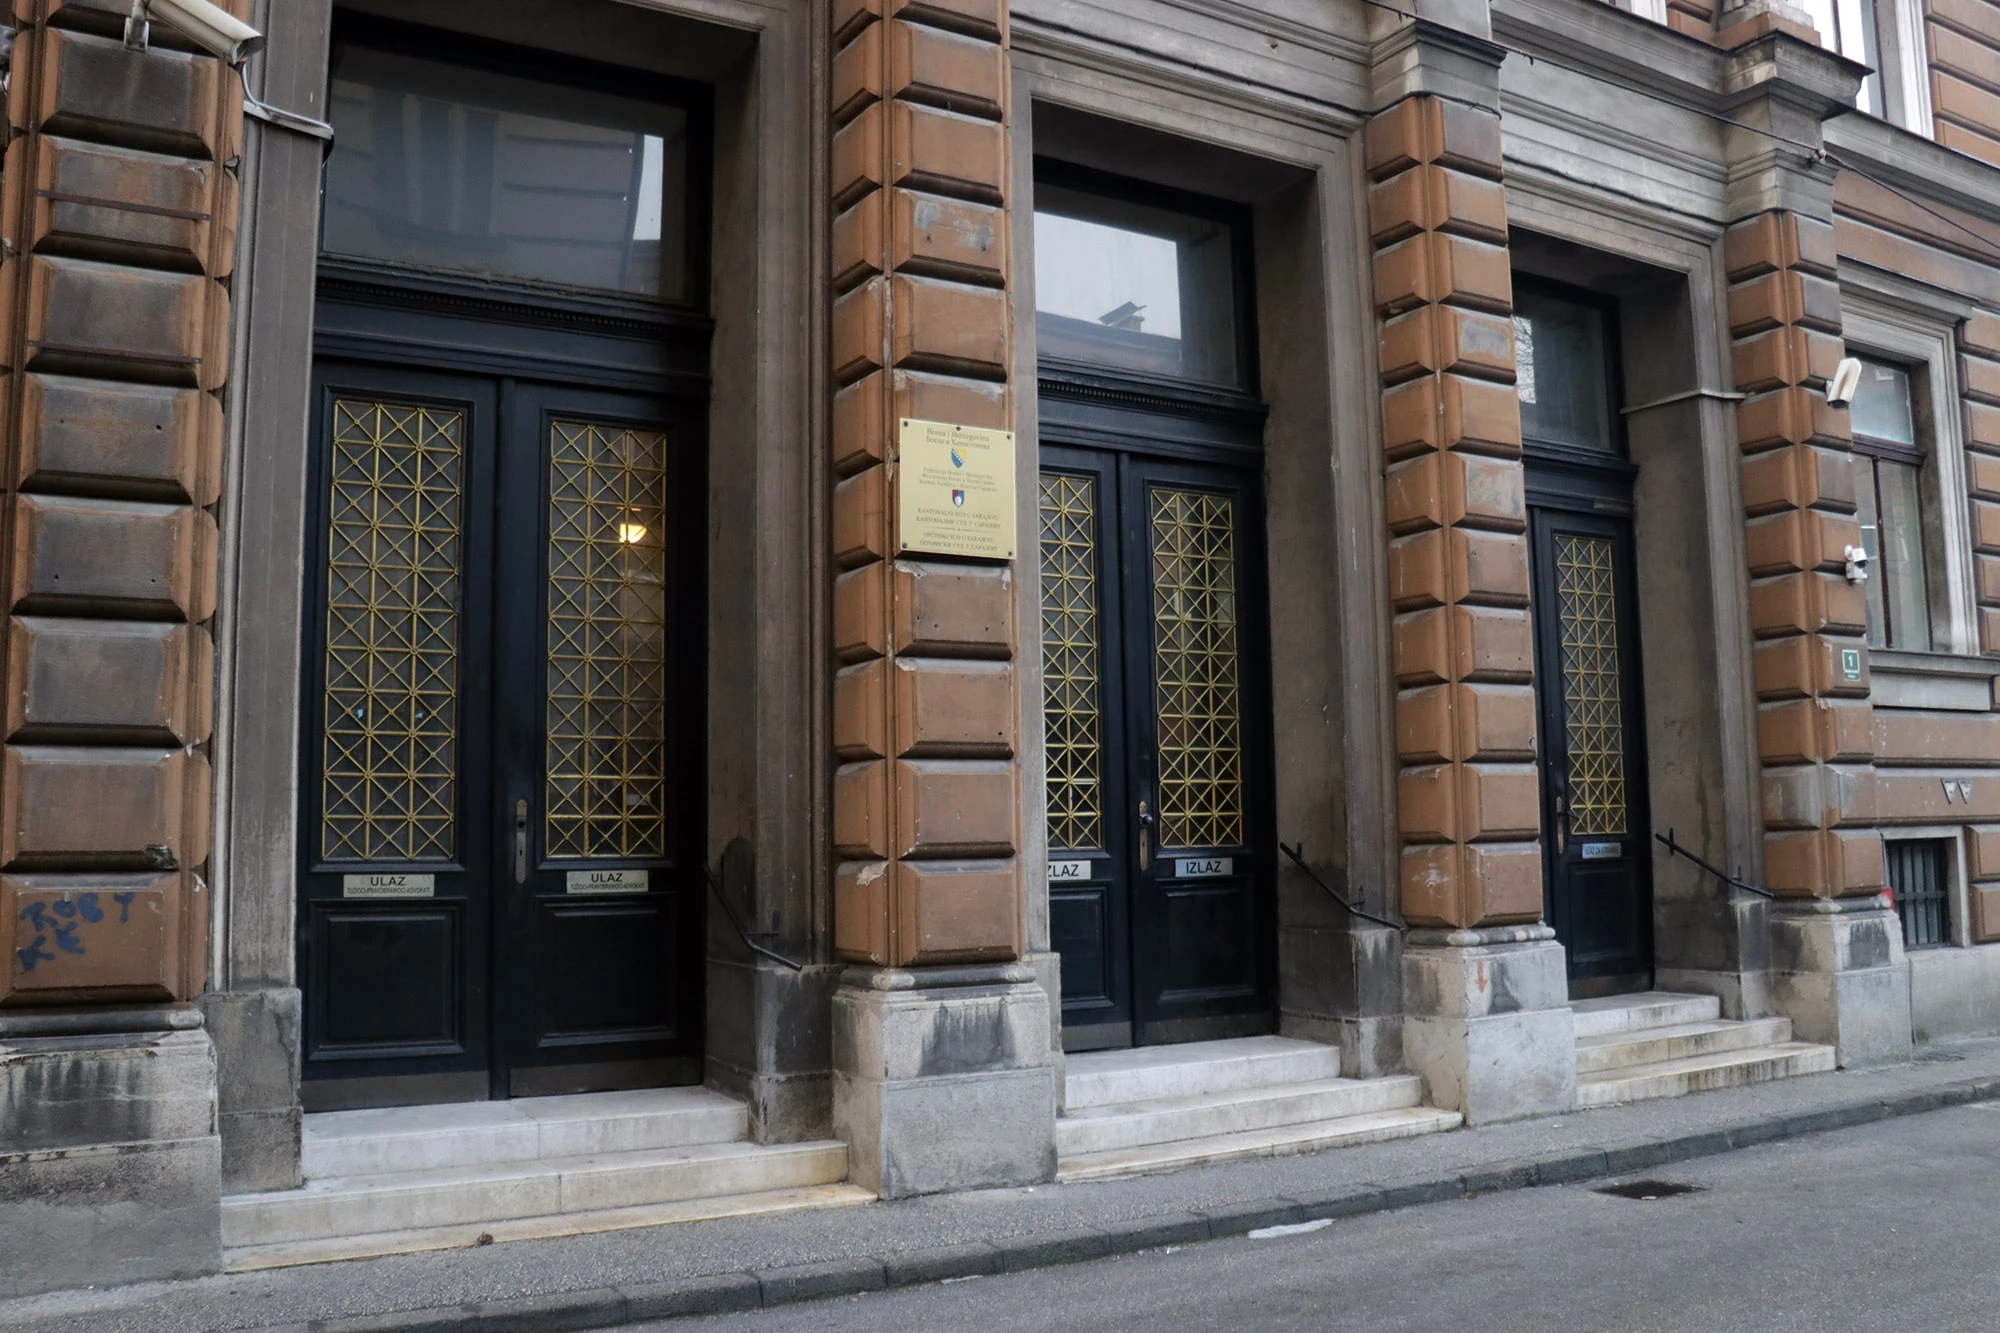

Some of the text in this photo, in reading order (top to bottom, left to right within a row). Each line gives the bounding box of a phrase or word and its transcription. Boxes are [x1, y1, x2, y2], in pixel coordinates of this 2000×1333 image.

[1848, 655, 1853, 667] 1
[1186, 861, 1222, 874] IZLAZ
[370, 876, 406, 887] ULAZ
[591, 873, 623, 883] ULAZ
